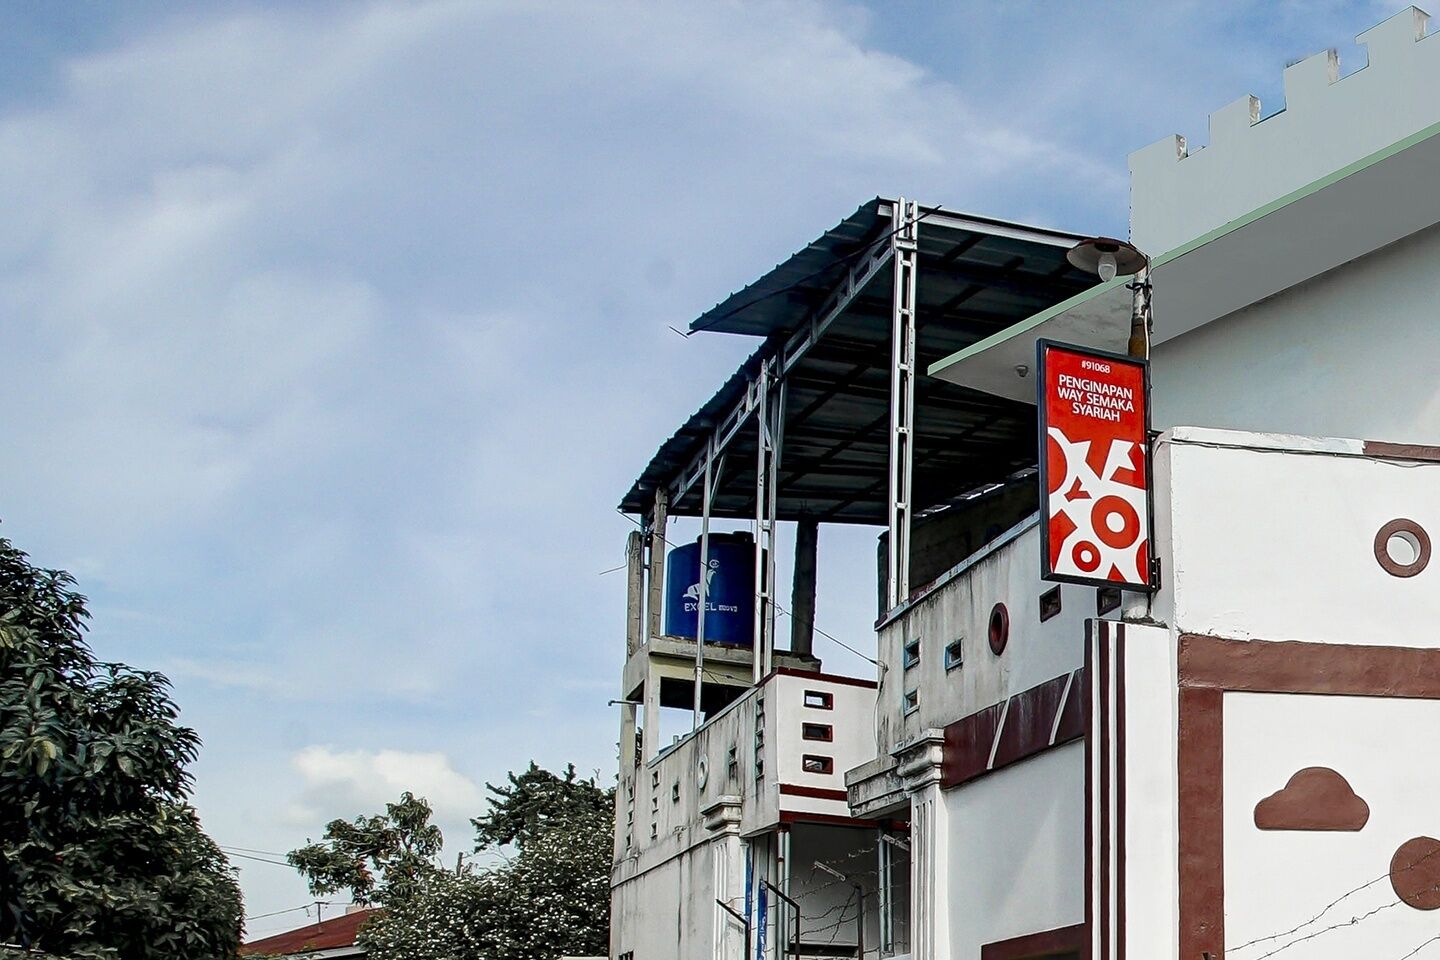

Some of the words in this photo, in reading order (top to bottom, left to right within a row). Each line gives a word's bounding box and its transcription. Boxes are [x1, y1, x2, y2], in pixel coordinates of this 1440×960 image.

[1081, 360, 1110, 373] #91068
[1059, 374, 1133, 400] PENGINAPAN
[1057, 386, 1084, 401] WAY
[1086, 392, 1134, 413] SEMAKA
[1072, 402, 1120, 422] SYARIAH
